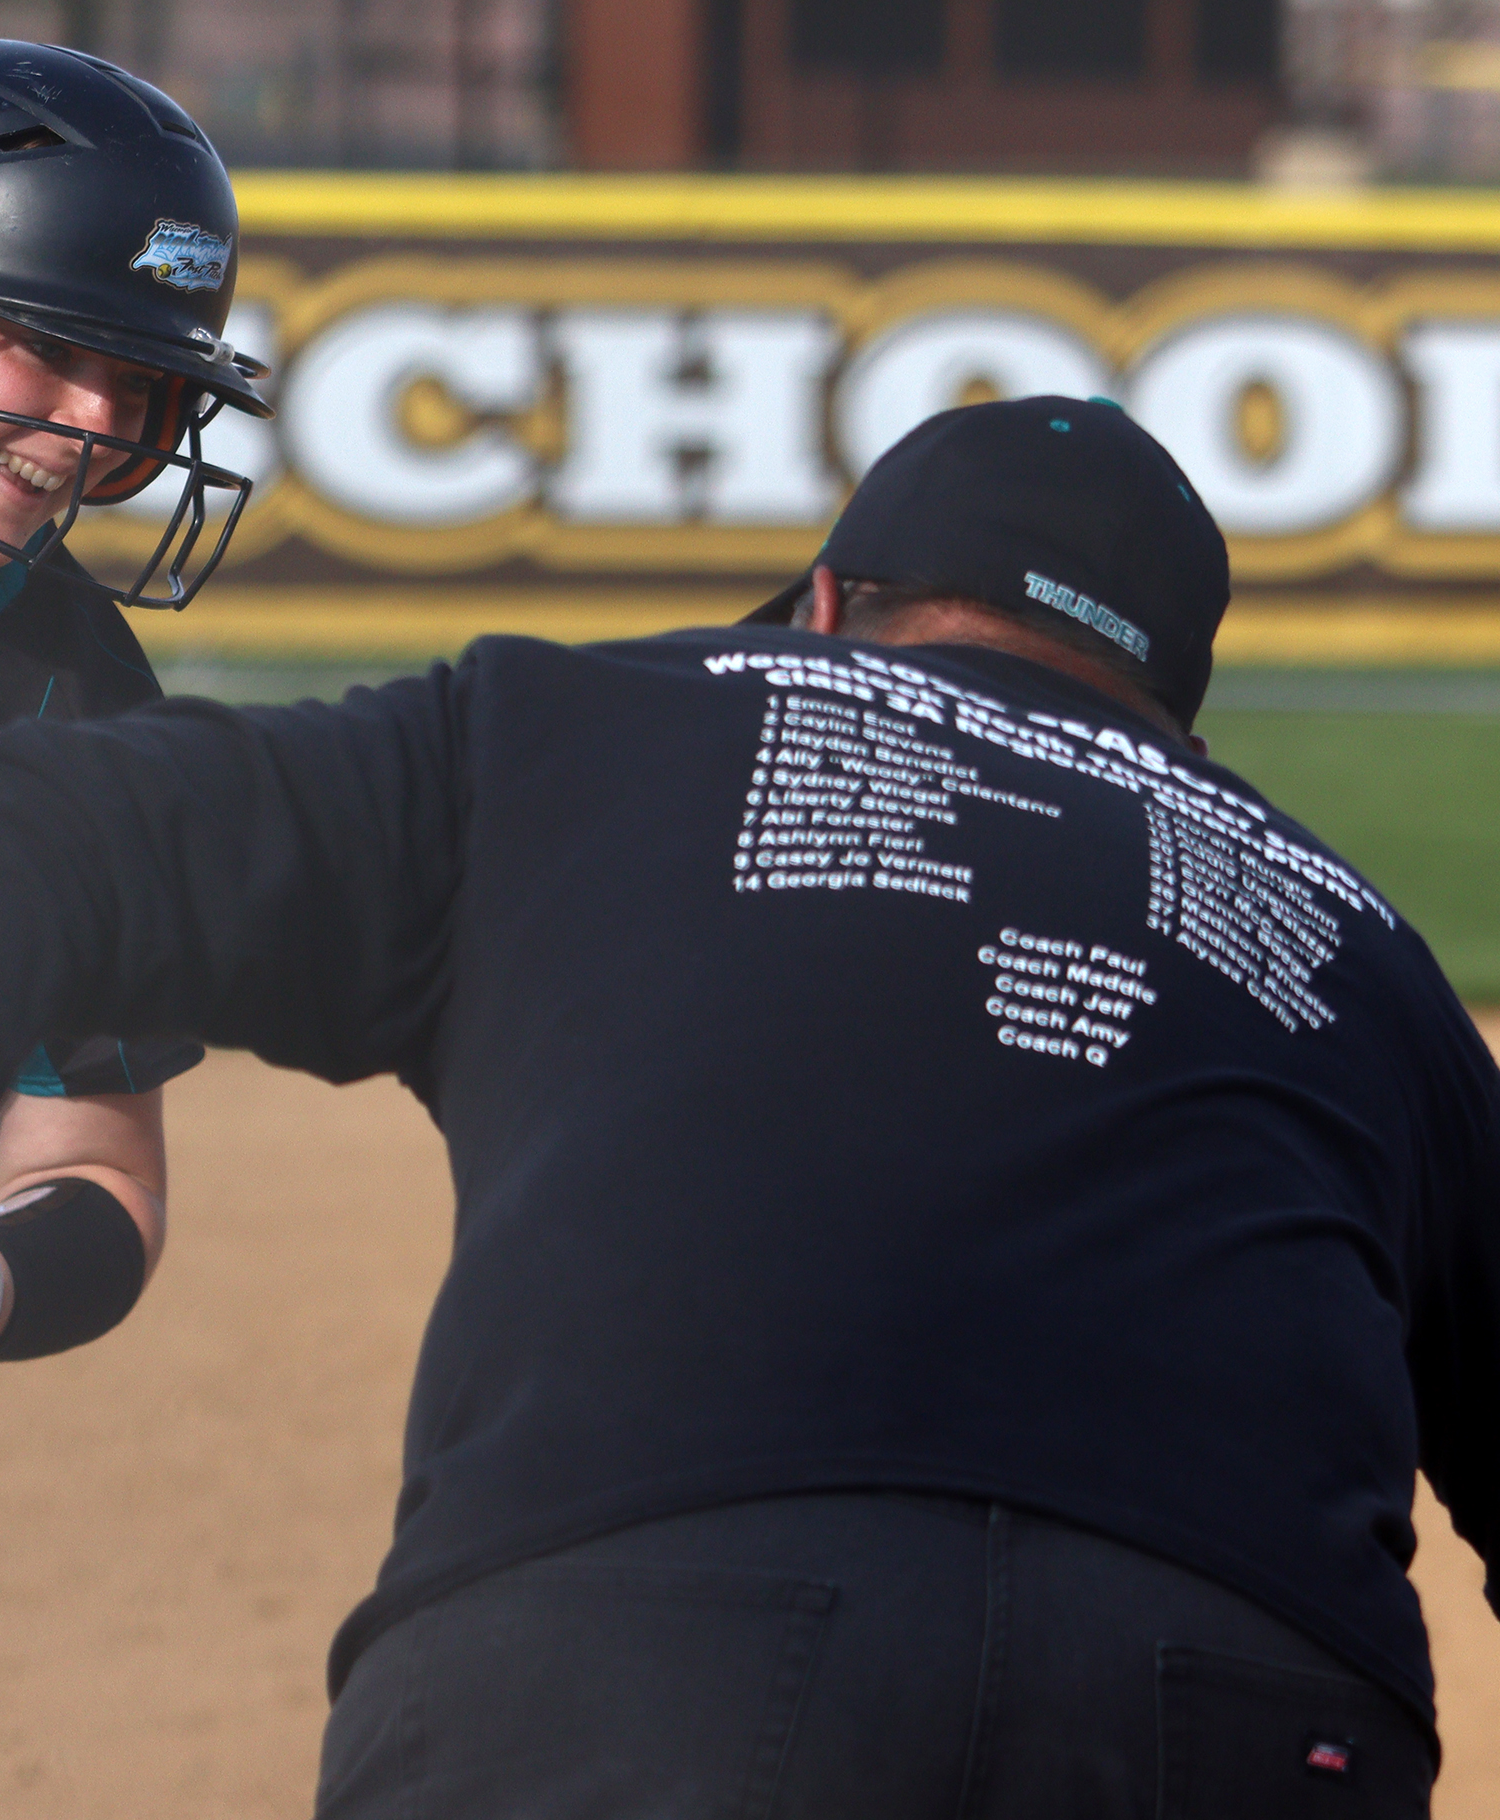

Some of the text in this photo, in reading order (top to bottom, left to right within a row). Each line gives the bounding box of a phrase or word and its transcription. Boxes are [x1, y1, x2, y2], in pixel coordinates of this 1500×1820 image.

[176, 256, 206, 273] Fast
[1023, 570, 1150, 664] THUNDER
[766, 694, 780, 711] 1
[786, 695, 859, 722] Emma
[703, 652, 945, 709] Woodstock
[956, 701, 1077, 758] North
[1086, 751, 1253, 833] Thunder
[760, 726, 979, 782] 3 Hayden Benedict
[763, 710, 779, 727] 2
[862, 725, 954, 761] Stevens
[752, 768, 768, 786] 5
[772, 768, 863, 793] Sydney
[755, 747, 772, 765] 4
[775, 748, 823, 770] Ally
[941, 775, 1063, 819] Celentano
[764, 668, 1364, 912] Class 3A Regional Champions
[743, 808, 916, 833] 7 Abi Forester
[746, 788, 957, 826] 6 Liberty Stevens
[733, 850, 751, 871] 9
[755, 849, 833, 869] Casey
[839, 848, 871, 868] Jo
[737, 829, 754, 849] 8
[758, 828, 862, 849] Ashlynn
[1178, 840, 1239, 879] Addie
[733, 869, 971, 904] 14 Georgia Sedlack
[1181, 881, 1255, 934] Gianna
[999, 926, 1148, 978] Coach Paul
[1179, 912, 1261, 981] Madison
[1181, 896, 1264, 962] Madison
[1266, 956, 1337, 1025] Wheeler
[977, 944, 1158, 1006] Coach Maddie
[994, 972, 1135, 1021] Coach Jeff
[1176, 930, 1244, 986] Alyssa
[1246, 979, 1299, 1034] Carlin
[984, 994, 1132, 1049] Coach Amy
[997, 1024, 1109, 1068] Coach Q
